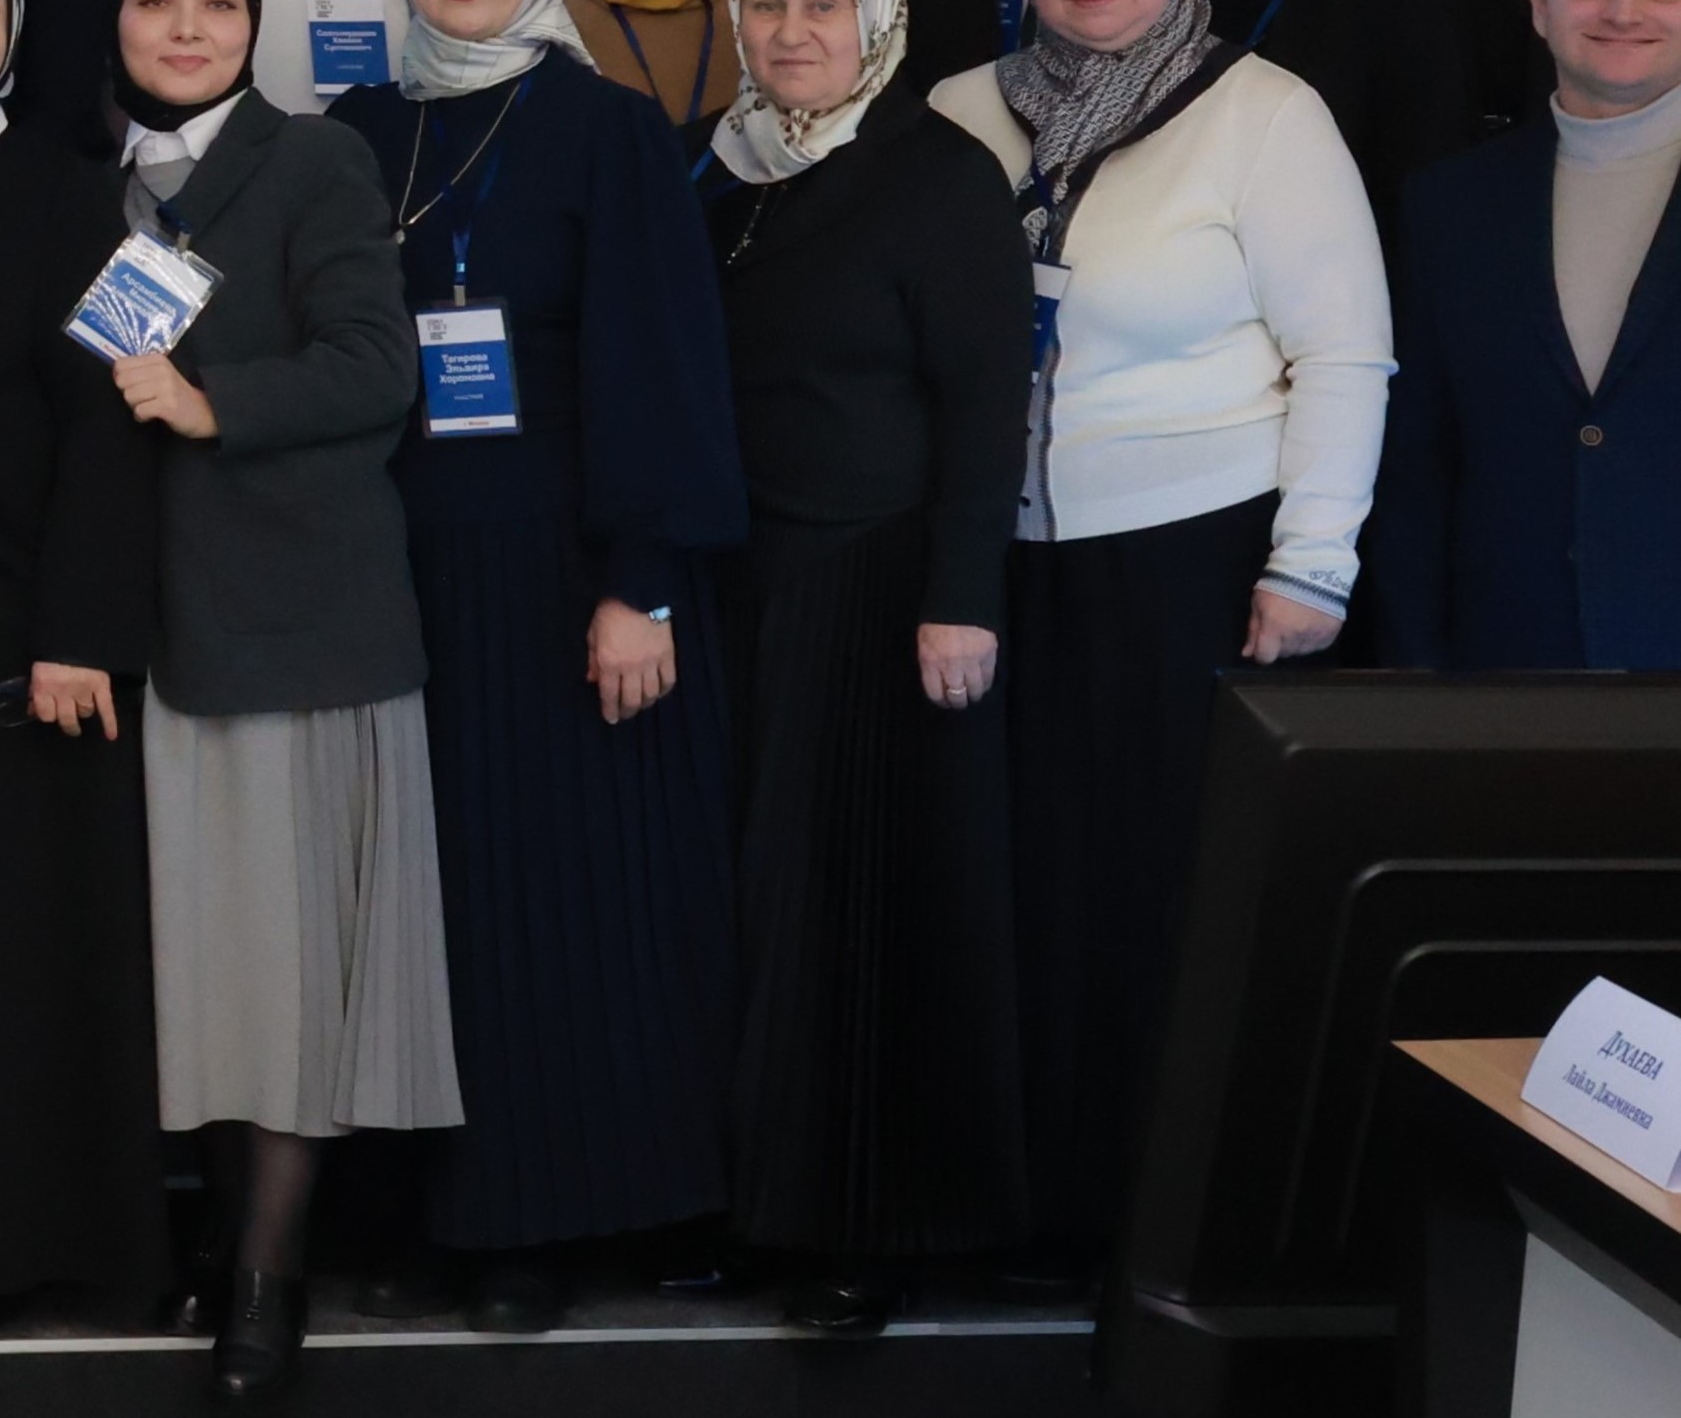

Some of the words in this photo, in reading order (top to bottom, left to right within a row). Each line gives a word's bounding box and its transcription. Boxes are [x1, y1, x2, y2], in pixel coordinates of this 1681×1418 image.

[1597, 1029, 1664, 1081] ДУХАЕВА
[1563, 1063, 1597, 1096] Лайла
[1593, 1081, 1655, 1130] Джамиевна
